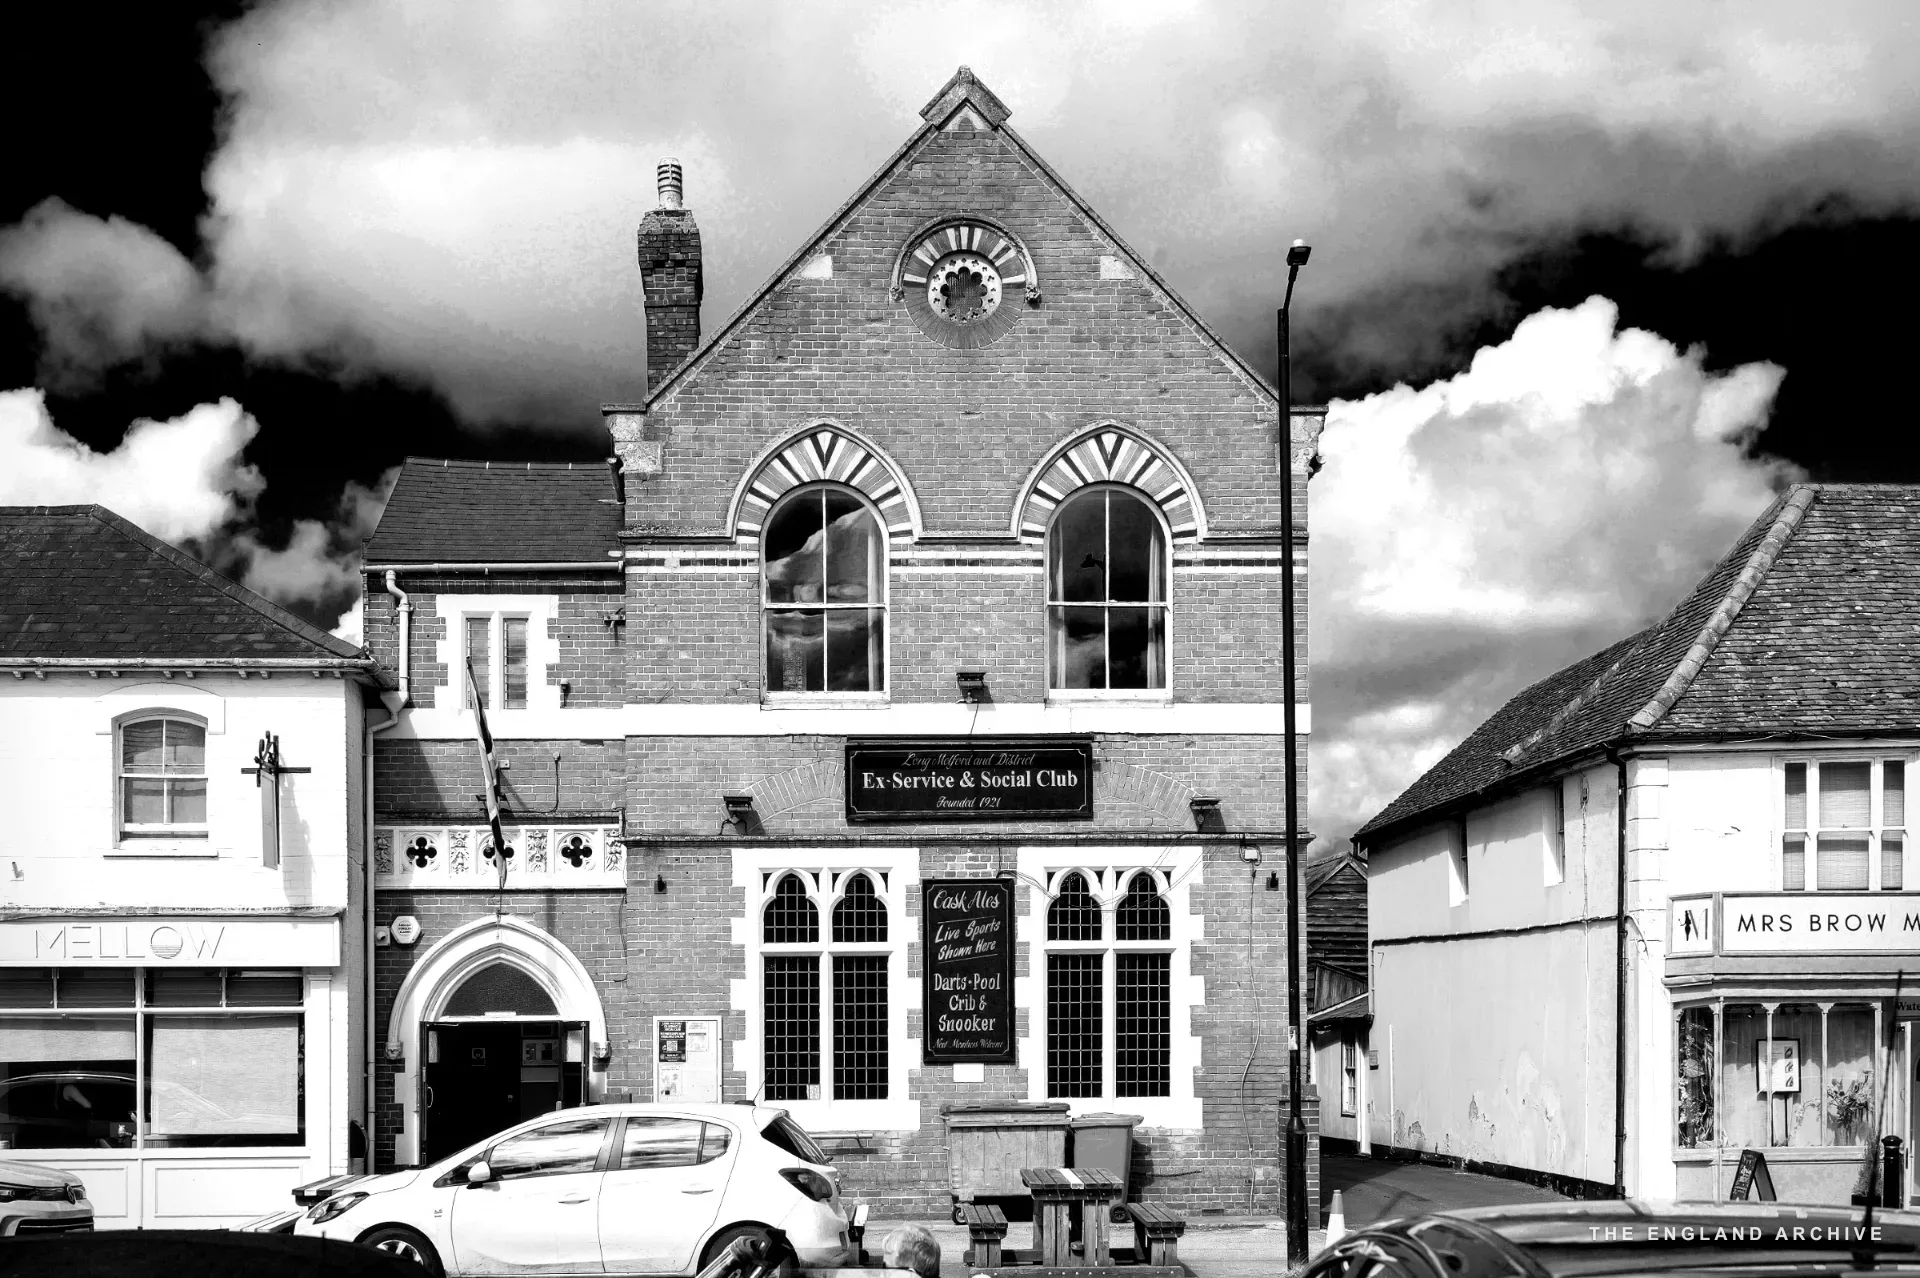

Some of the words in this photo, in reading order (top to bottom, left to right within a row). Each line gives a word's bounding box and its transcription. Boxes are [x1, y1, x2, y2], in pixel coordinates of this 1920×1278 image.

[902, 752, 929, 772] Long
[932, 753, 972, 771] Melford
[973, 754, 993, 766] and
[995, 752, 1035, 766] District
[862, 771, 955, 789] Ex-Service
[959, 771, 976, 788] &
[980, 771, 1031, 788] Social
[1036, 770, 1078, 787] Club
[936, 796, 976, 808] Founded
[979, 796, 1001, 808] 1921
[933, 889, 969, 912] Cask
[967, 890, 1000, 909] Ales
[935, 924, 961, 943] Live
[965, 918, 1001, 941] Sports
[1738, 914, 1793, 933] MRS
[1809, 914, 1886, 933] BROW
[35, 926, 225, 959] MELLOW
[938, 944, 973, 961] Shown
[975, 938, 997, 953] Here
[949, 994, 976, 1011] Crib
[979, 994, 988, 1011] &
[939, 1014, 996, 1032] Snooker
